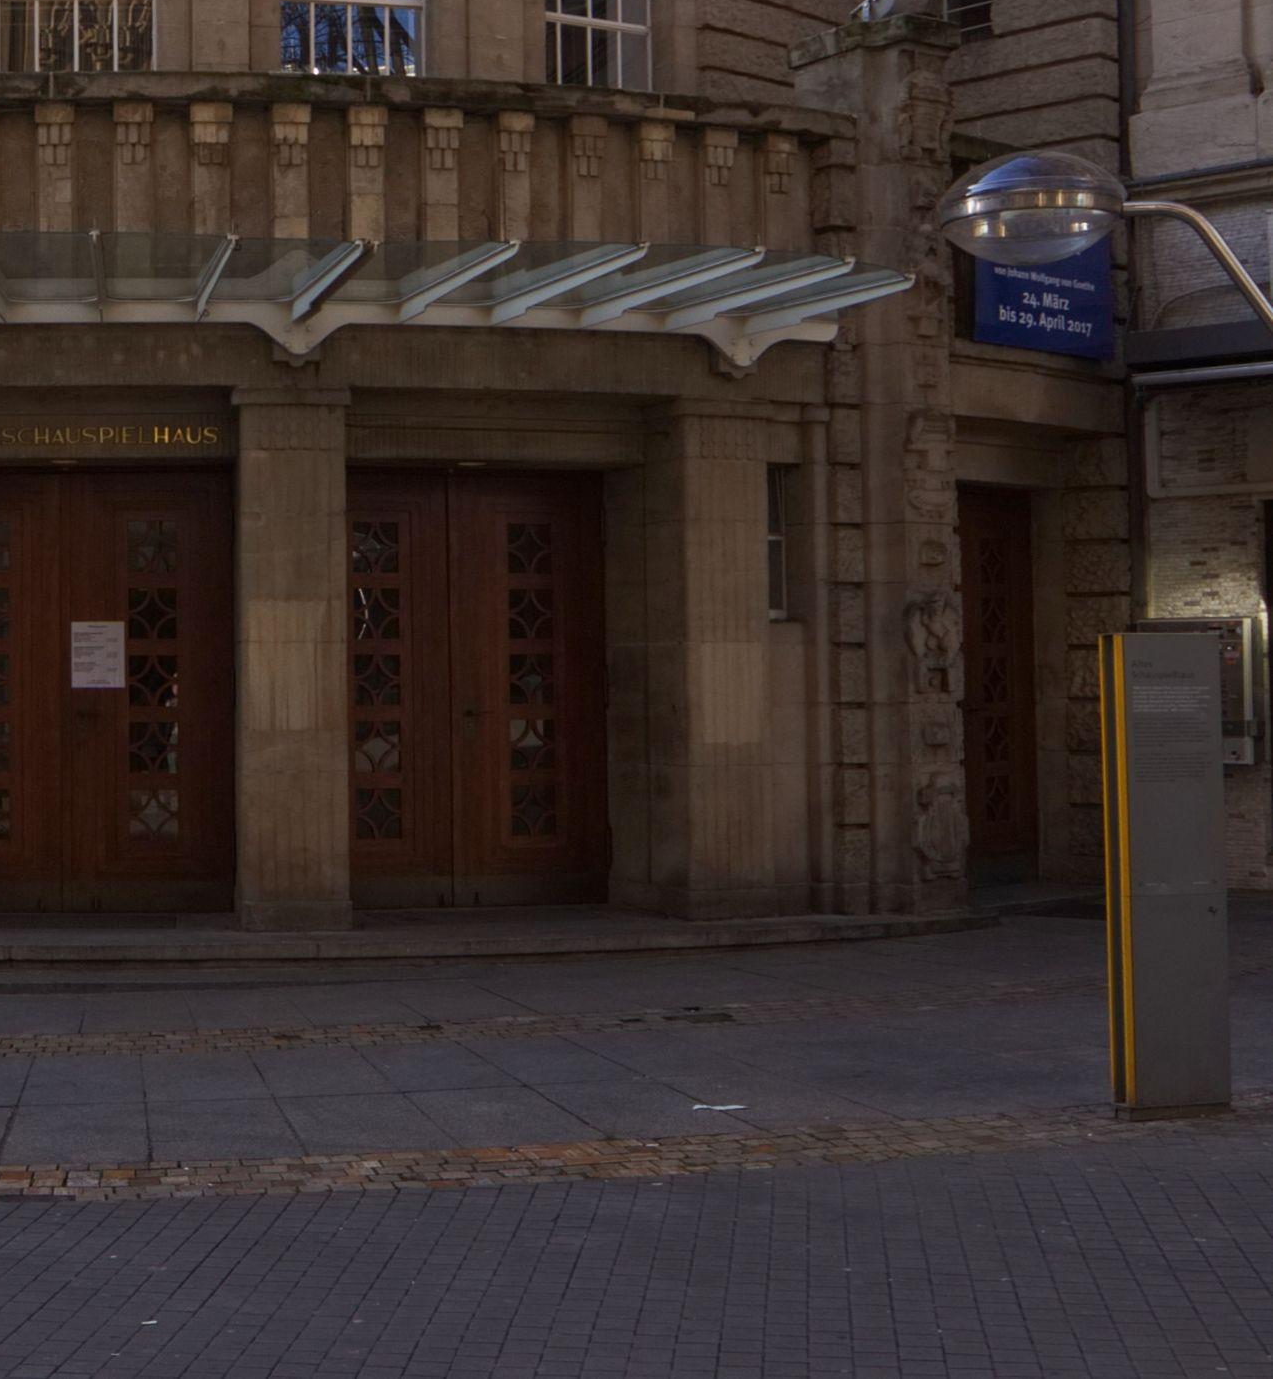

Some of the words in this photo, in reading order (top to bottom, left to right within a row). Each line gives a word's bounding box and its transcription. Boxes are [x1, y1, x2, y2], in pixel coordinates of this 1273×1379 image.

[1023, 292, 1040, 309] 24.
[1042, 293, 1070, 311] März
[999, 305, 1017, 323] bis
[1019, 312, 1037, 328] 29.
[1038, 312, 1065, 332] April
[1067, 320, 1092, 337] 2017
[2, 425, 219, 445] SCHAUSPIELHAUS
